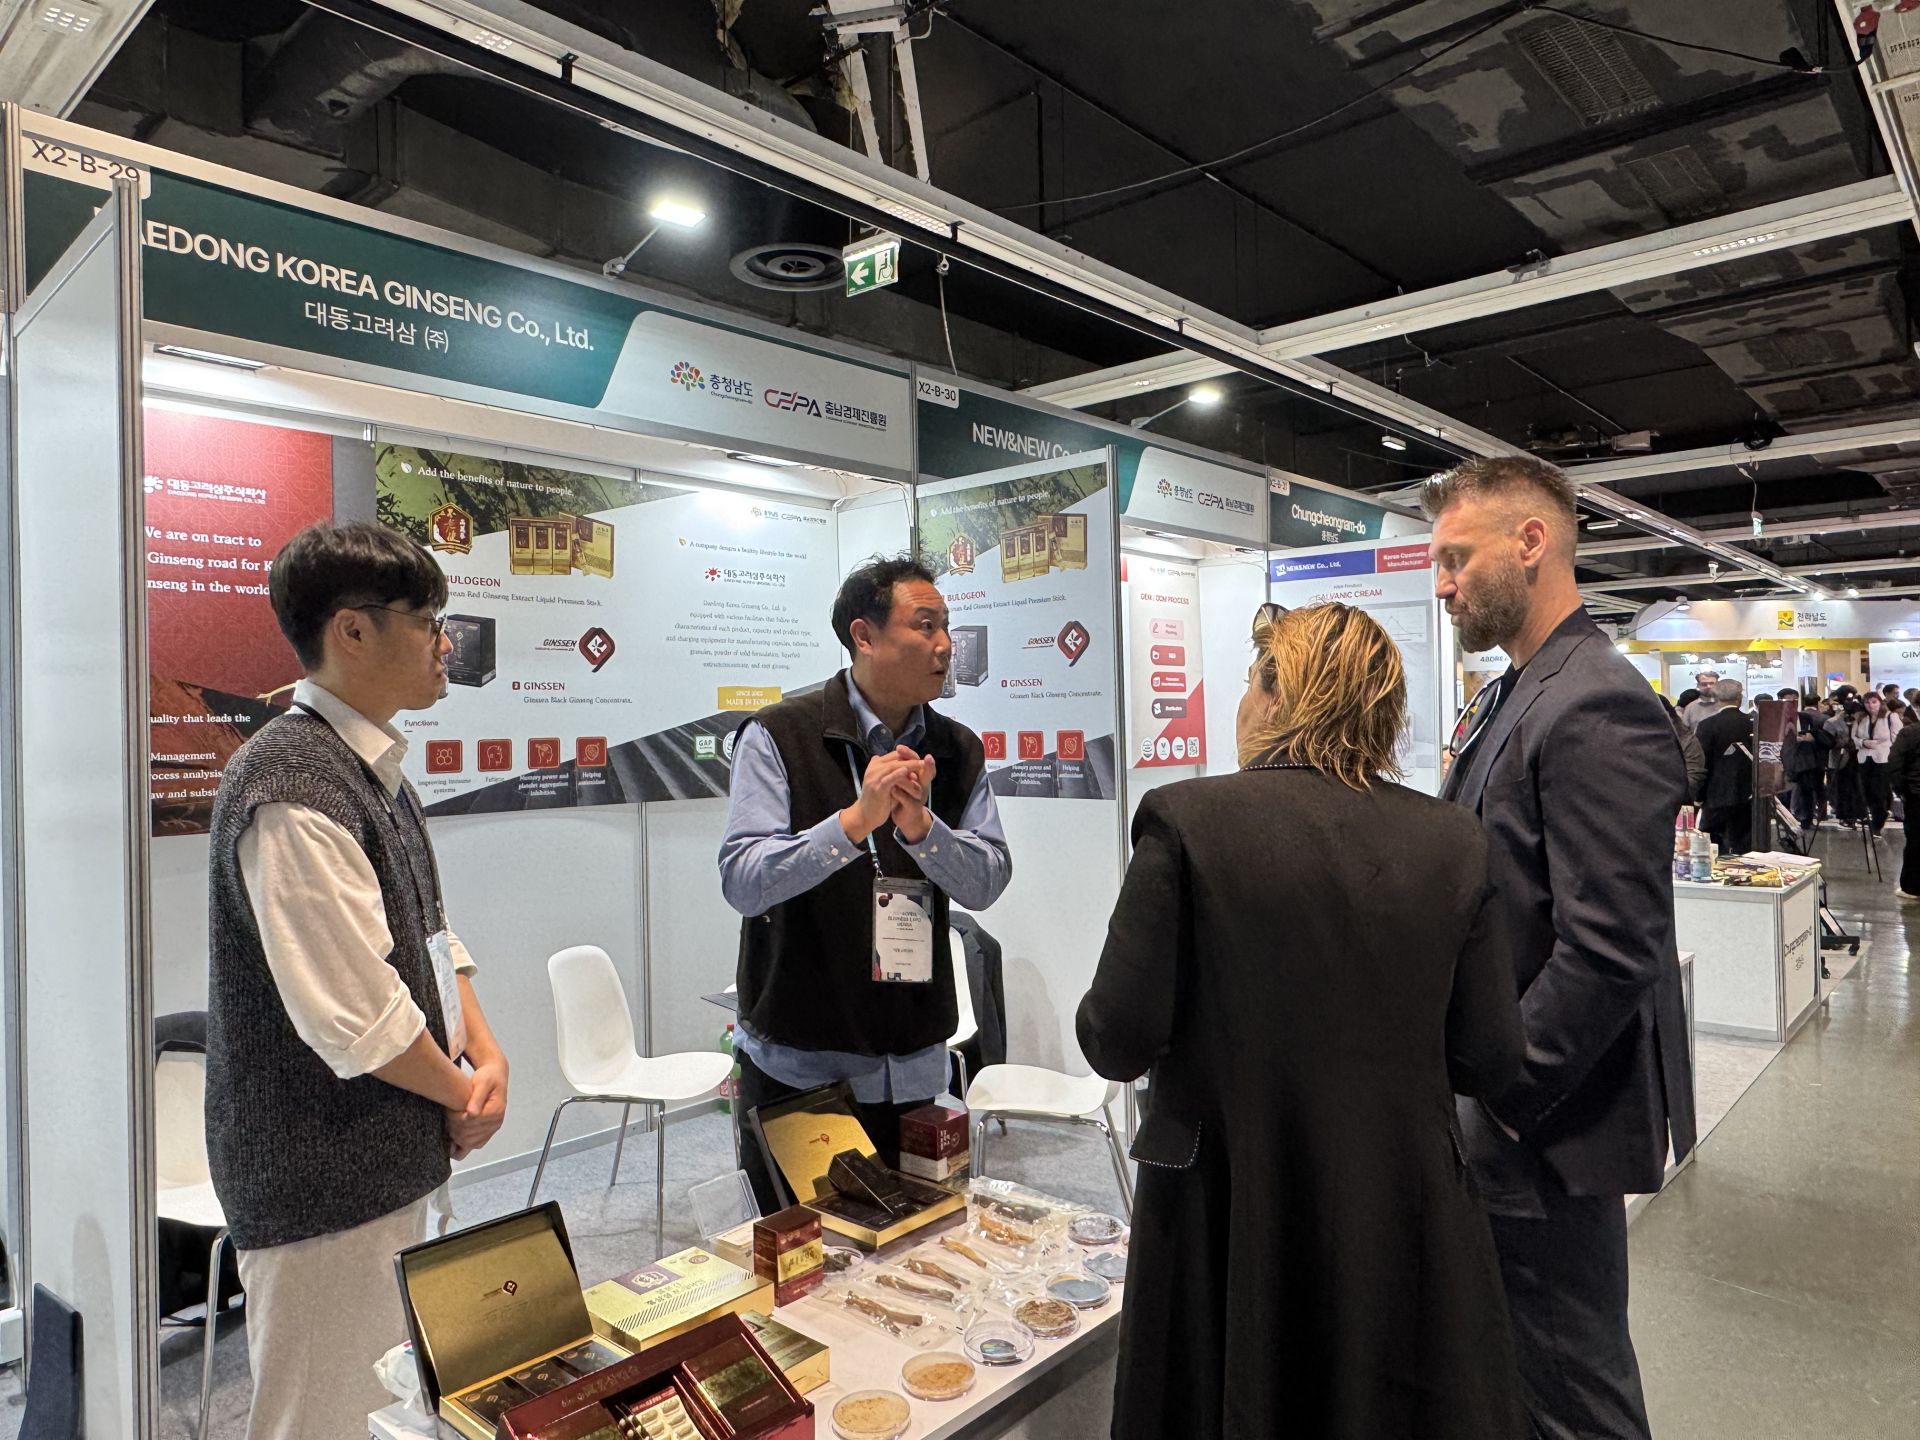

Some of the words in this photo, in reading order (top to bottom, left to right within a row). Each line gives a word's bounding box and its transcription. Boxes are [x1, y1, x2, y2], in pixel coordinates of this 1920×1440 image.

[32, 139, 140, 182] X2-B-29
[277, 252, 379, 301] KOREA
[384, 280, 502, 329] GINSENG
[507, 311, 550, 347] Co.,
[555, 321, 595, 351] Ltd.
[304, 301, 416, 346] 대동고려삼
[424, 325, 450, 354] (주)
[709, 374, 753, 398] 충청남도
[918, 381, 957, 401] X2-B-30
[764, 388, 822, 418] CEPA
[825, 401, 887, 427] 충남경제진흥원
[972, 422, 1051, 460] NEW&NEW
[417, 466, 436, 476] Add
[440, 468, 456, 480] the
[457, 472, 493, 486] benefits
[495, 476, 504, 486] of
[506, 480, 533, 491] nature
[535, 482, 544, 492] to
[546, 484, 575, 498] people.
[989, 498, 997, 507] of
[997, 496, 1020, 505] nature
[1019, 494, 1026, 502] to
[1198, 492, 1225, 510] CEPA
[1292, 503, 1366, 535] Chungcheongnam-do
[166, 530, 188, 541] are
[192, 532, 209, 543] on
[213, 534, 244, 546] tract
[248, 536, 262, 547] to
[147, 551, 204, 569] Ginseng
[207, 557, 238, 570] road
[241, 559, 260, 571] for
[146, 579, 188, 592] nseng
[192, 579, 205, 592] in
[209, 581, 231, 593] the
[446, 575, 501, 588] ULOGEON
[467, 590, 481, 598] Red
[482, 591, 510, 601] Ginseng
[511, 593, 534, 602] Extract
[536, 595, 556, 605] Liquid
[947, 590, 986, 602] BULOGEON
[1354, 588, 1383, 598] CREAM
[1797, 612, 1827, 622] 전라남도
[543, 638, 578, 648] GINSSEN
[523, 681, 565, 690] GINSSEN
[1009, 679, 1043, 688] GINSSEN
[568, 696, 594, 705] Ginseng
[150, 713, 180, 724] uality
[183, 713, 204, 723] that
[207, 713, 232, 723] leads
[235, 713, 251, 723] the
[404, 719, 439, 727] Functions
[698, 739, 713, 747] GAP
[150, 752, 216, 763] Management
[183, 769, 223, 780] analysis
[168, 789, 187, 799] and
